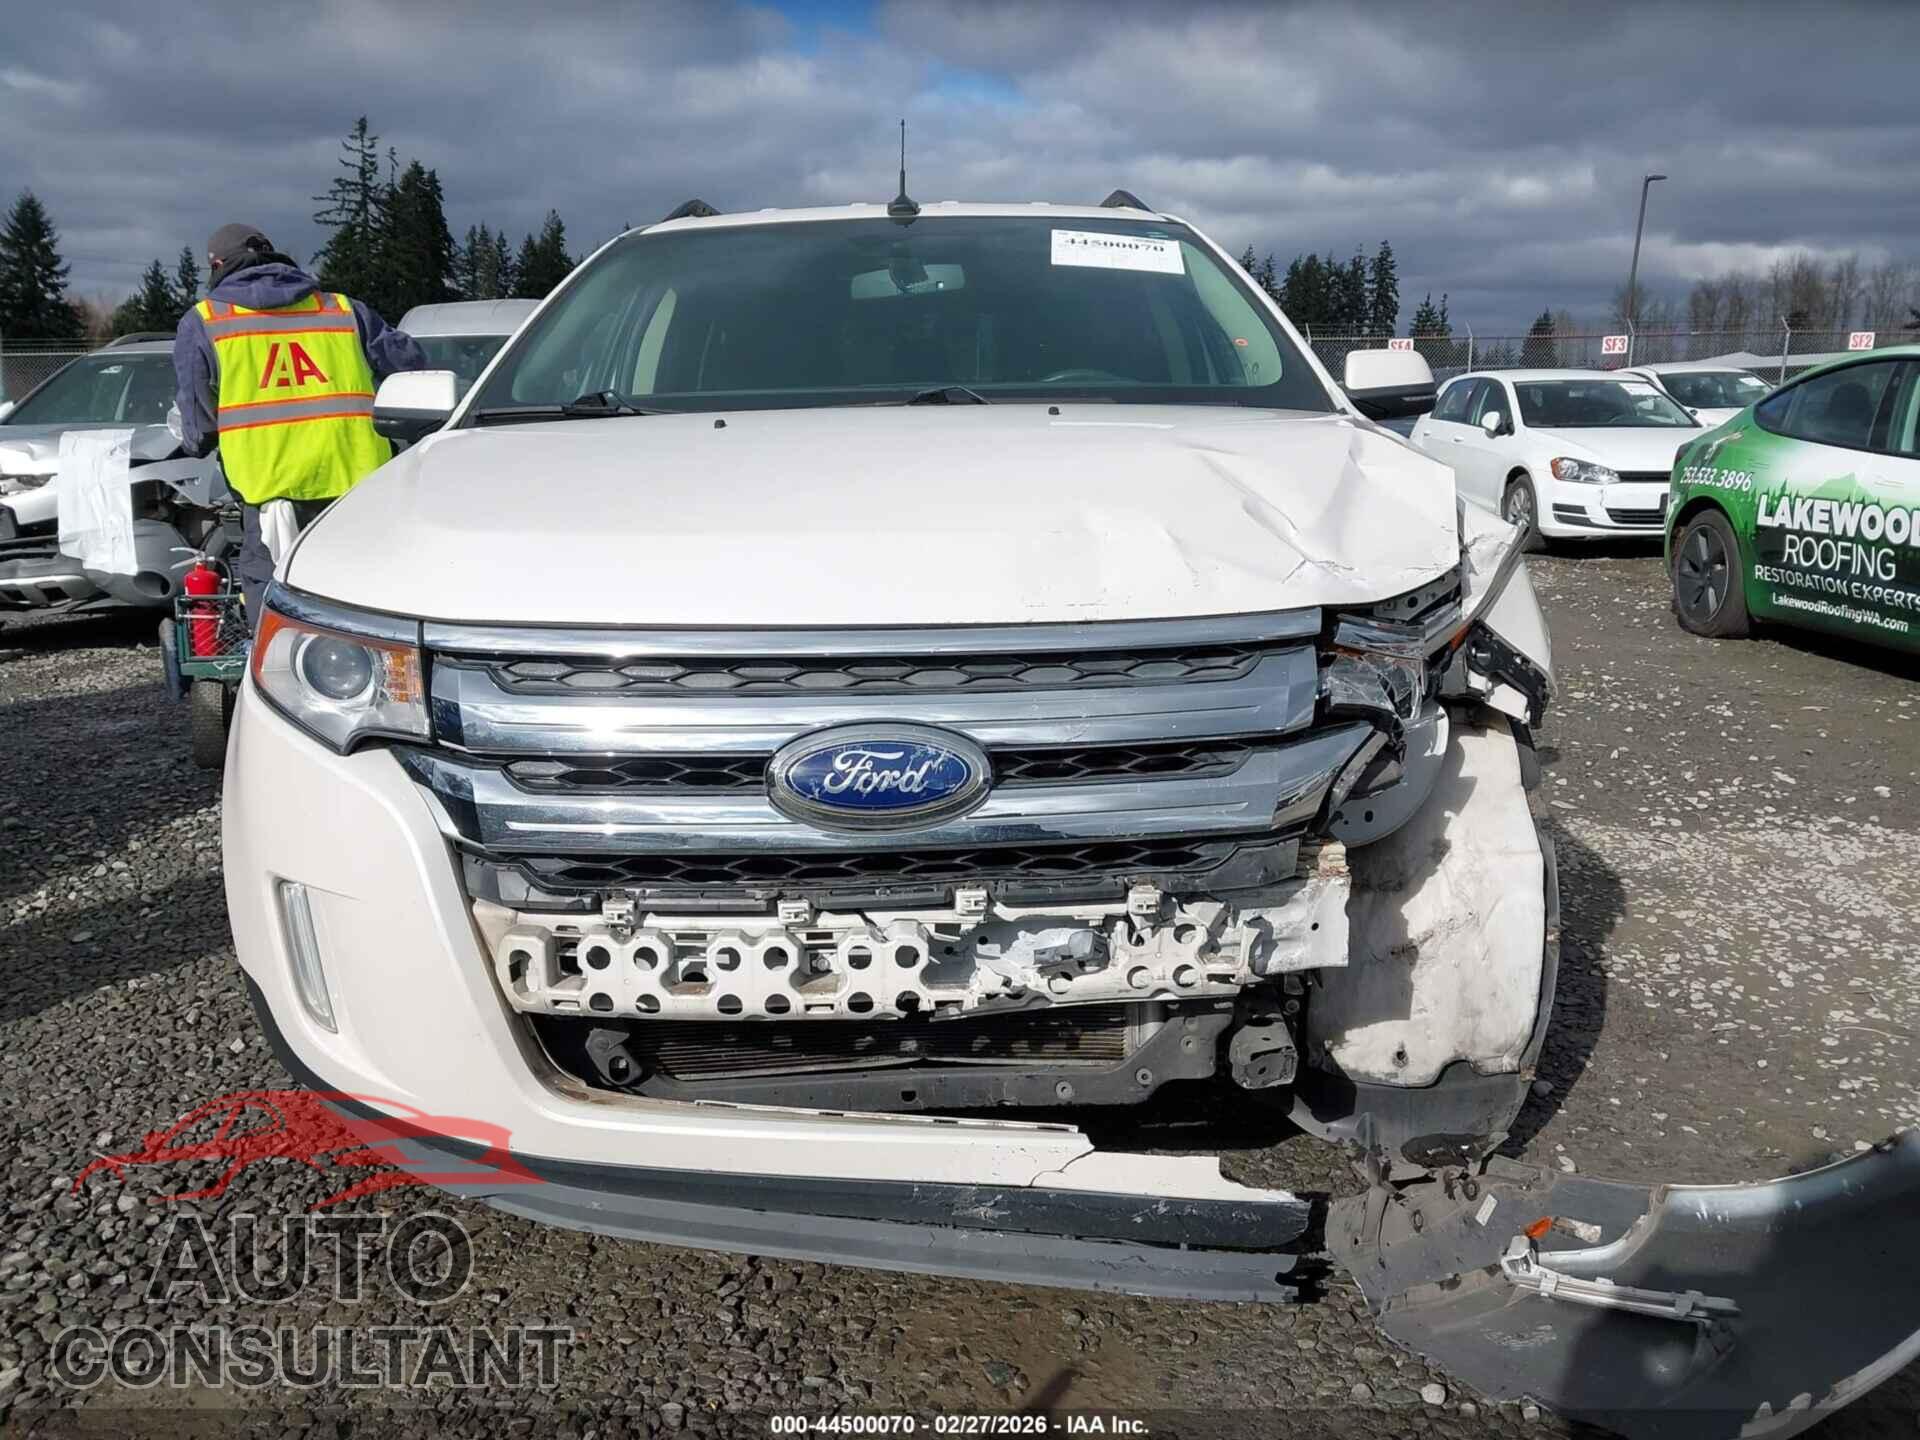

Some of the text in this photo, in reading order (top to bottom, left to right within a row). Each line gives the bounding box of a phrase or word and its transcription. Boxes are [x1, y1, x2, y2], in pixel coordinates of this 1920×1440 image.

[1604, 337, 1626, 352] SF3
[1852, 334, 1873, 348] SF2
[1783, 534, 1897, 581] ROOFING
[1755, 564, 1848, 596] RESTORATION
[1772, 592, 1909, 633] LakewoodRoofingWA.com
[823, 750, 929, 794] Ford
